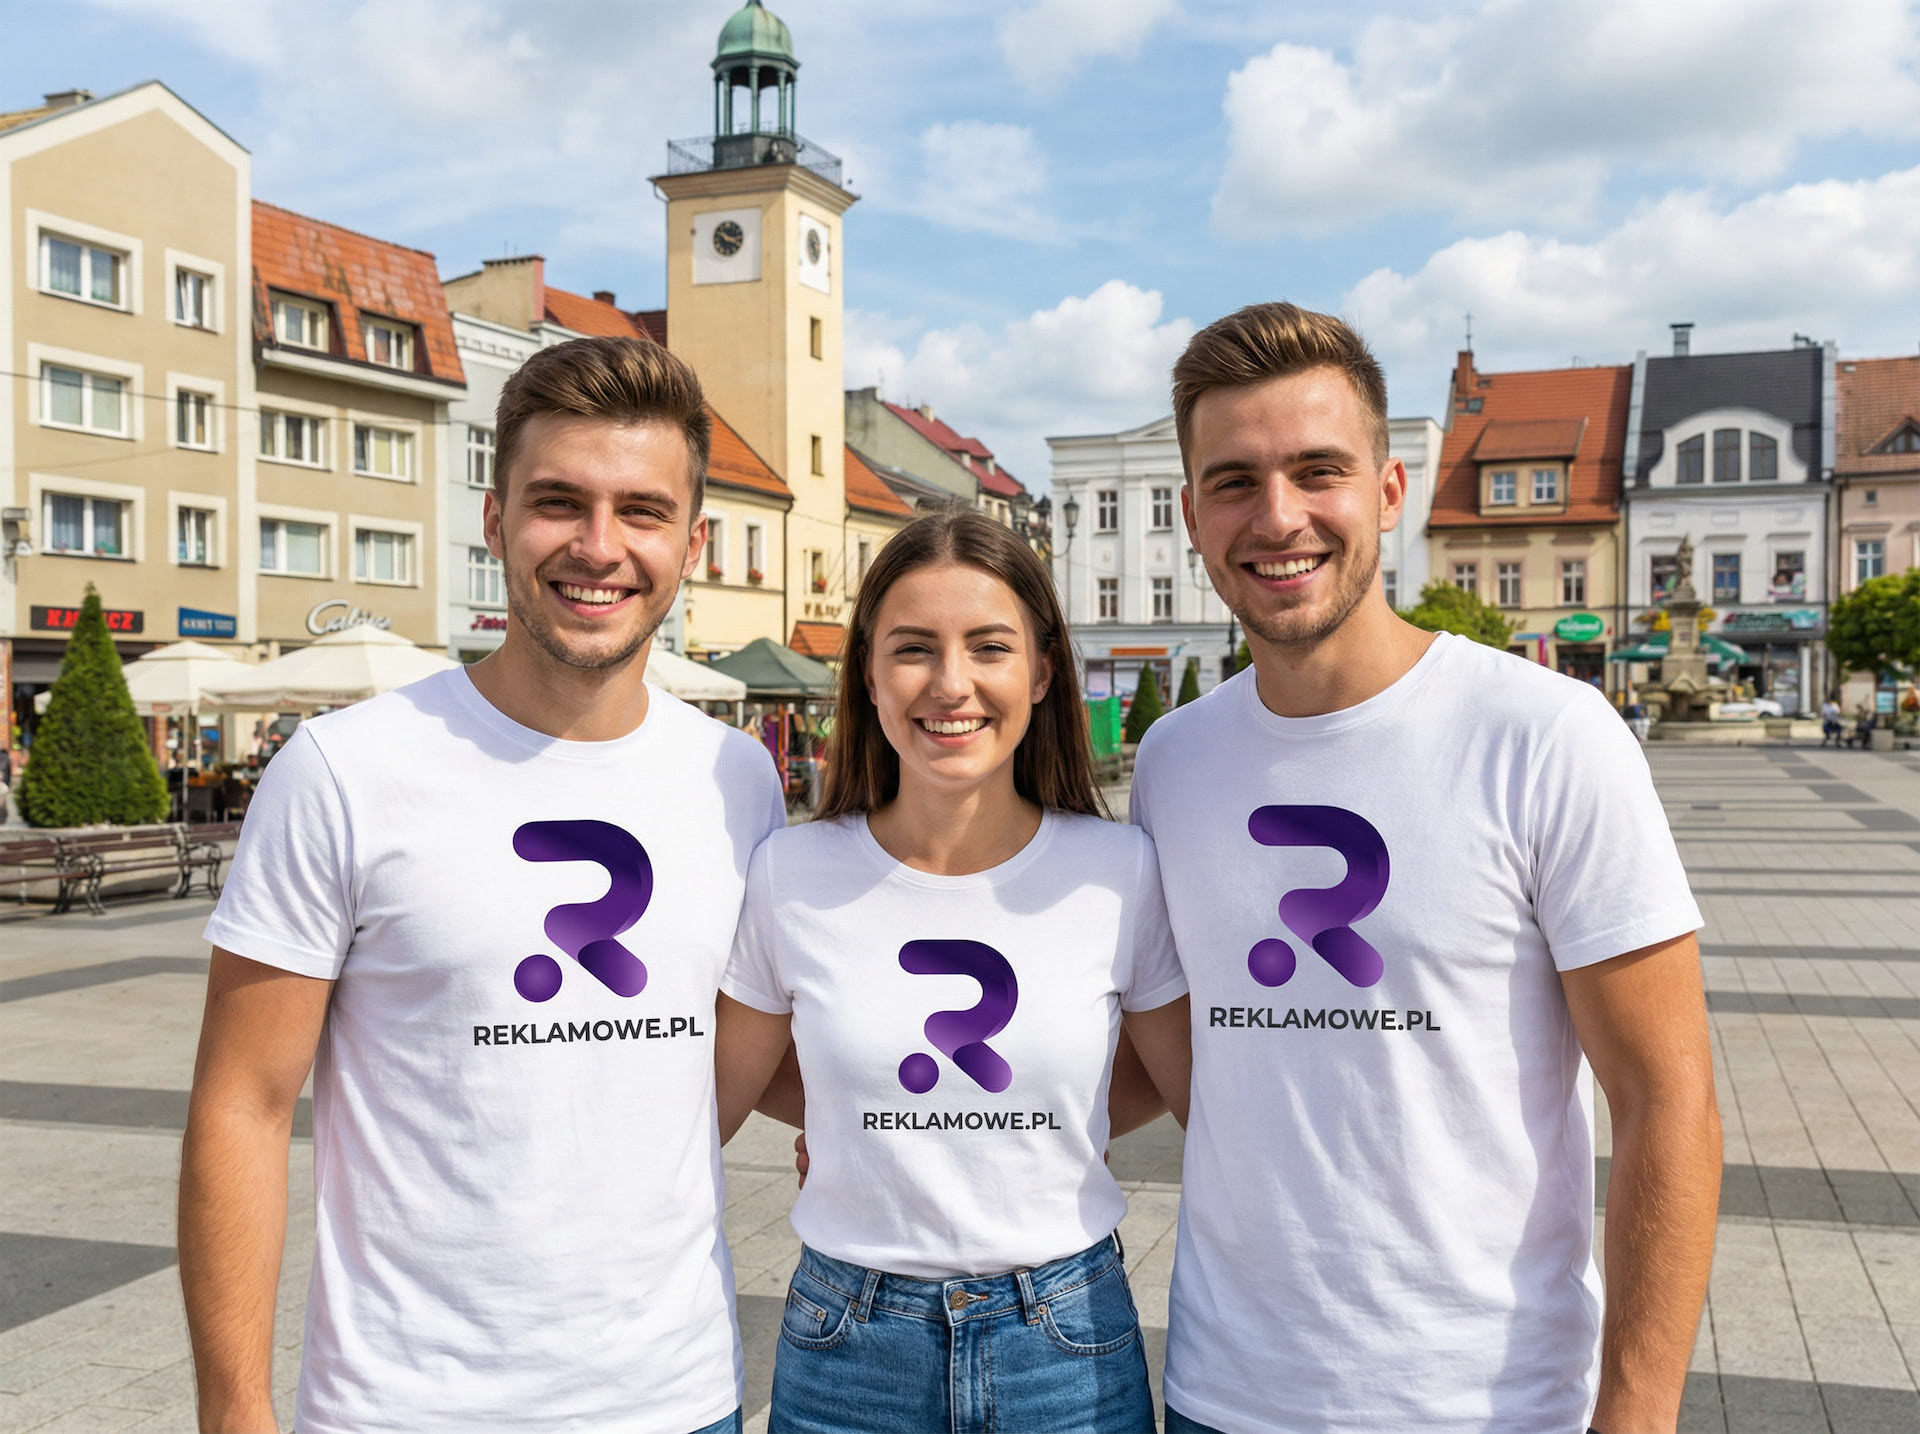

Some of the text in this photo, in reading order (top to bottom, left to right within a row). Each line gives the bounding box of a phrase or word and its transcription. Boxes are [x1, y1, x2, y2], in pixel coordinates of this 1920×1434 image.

[474, 1016, 704, 1046] REKLAMOWE.PL
[1210, 1007, 1440, 1031] REKLAMOWE.PL
[863, 1112, 1061, 1130] REKLAMOWE.PL
